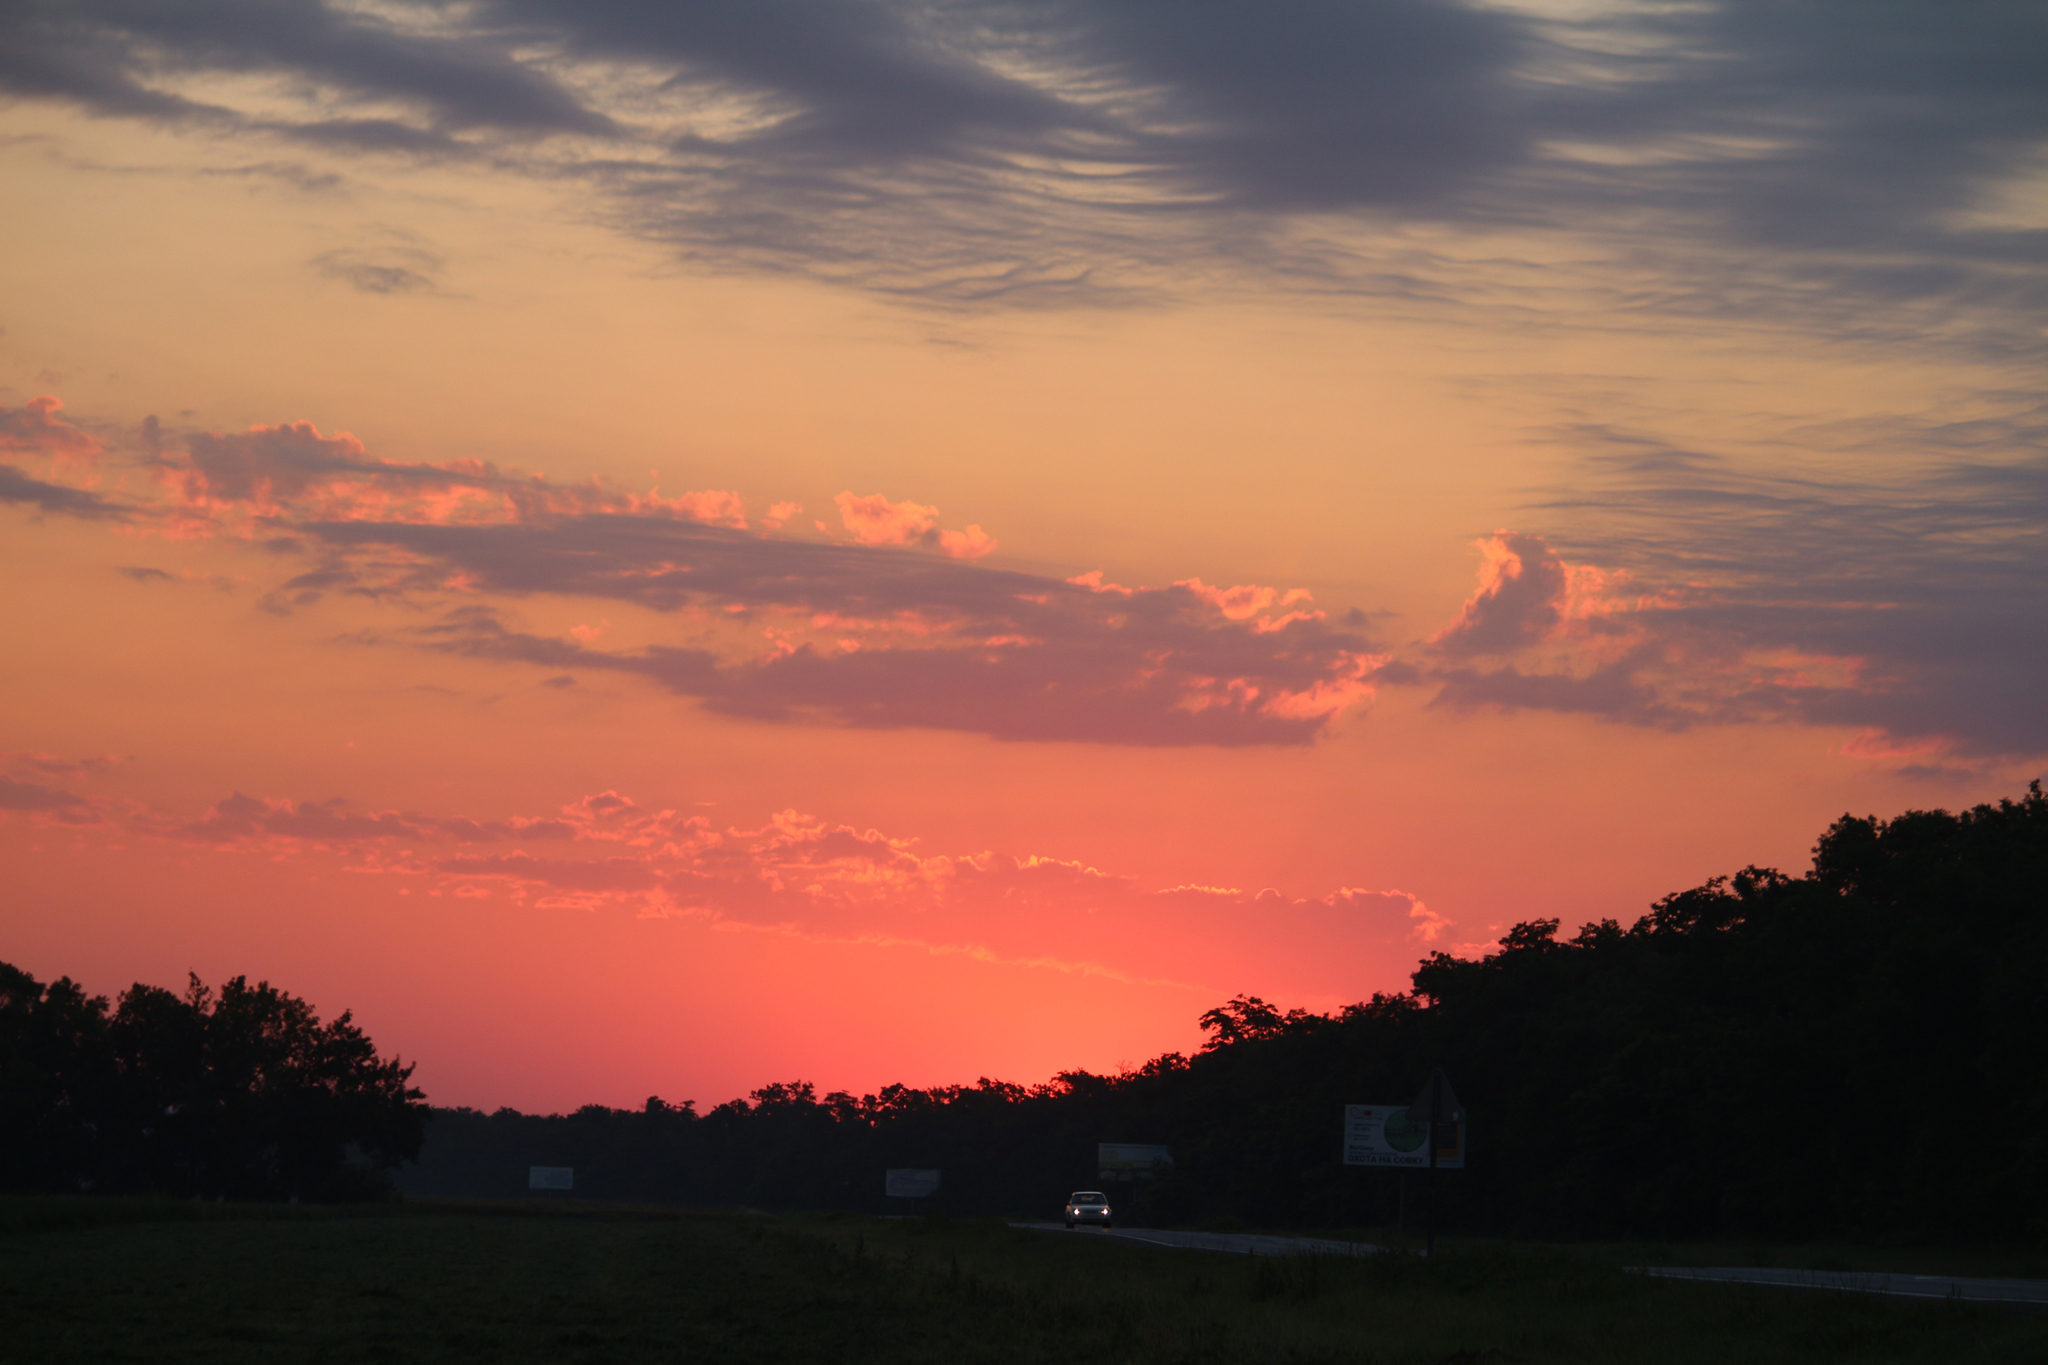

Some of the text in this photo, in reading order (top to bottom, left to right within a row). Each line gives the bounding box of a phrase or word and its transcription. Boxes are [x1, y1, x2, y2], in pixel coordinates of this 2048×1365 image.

[1347, 1155, 1424, 1165] ОХОТА НА СОВКУ
